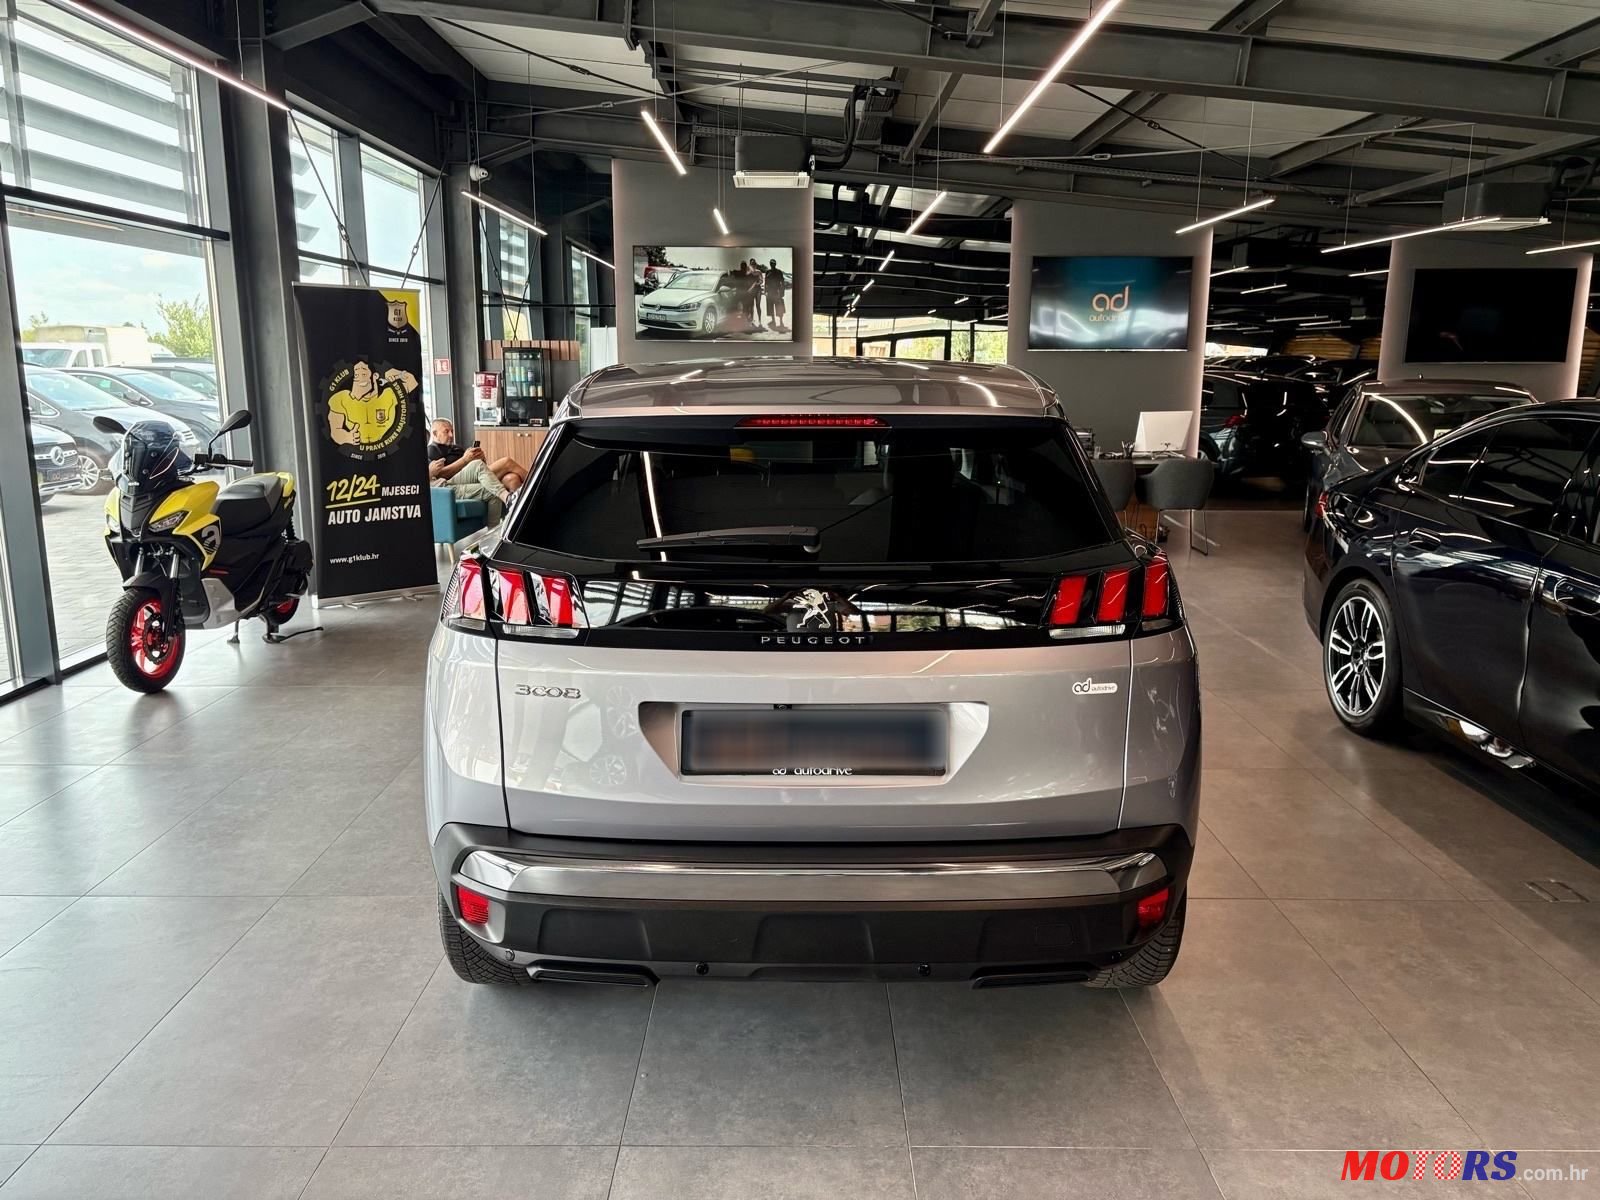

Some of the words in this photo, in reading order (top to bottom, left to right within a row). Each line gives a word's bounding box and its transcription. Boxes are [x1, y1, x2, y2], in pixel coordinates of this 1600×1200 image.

[1092, 285, 1129, 312] ad
[329, 382, 337, 392] G1
[335, 368, 350, 382] KLUB
[365, 442, 385, 452] PRAVE
[384, 431, 399, 446] RUKE
[326, 474, 381, 502] 12/24
[381, 484, 420, 497] MJESECI
[327, 508, 361, 526] AUTO
[364, 504, 422, 522] JAMSTVA
[329, 553, 380, 565] www.g1klub.hr
[760, 636, 865, 645] PEUGEOT
